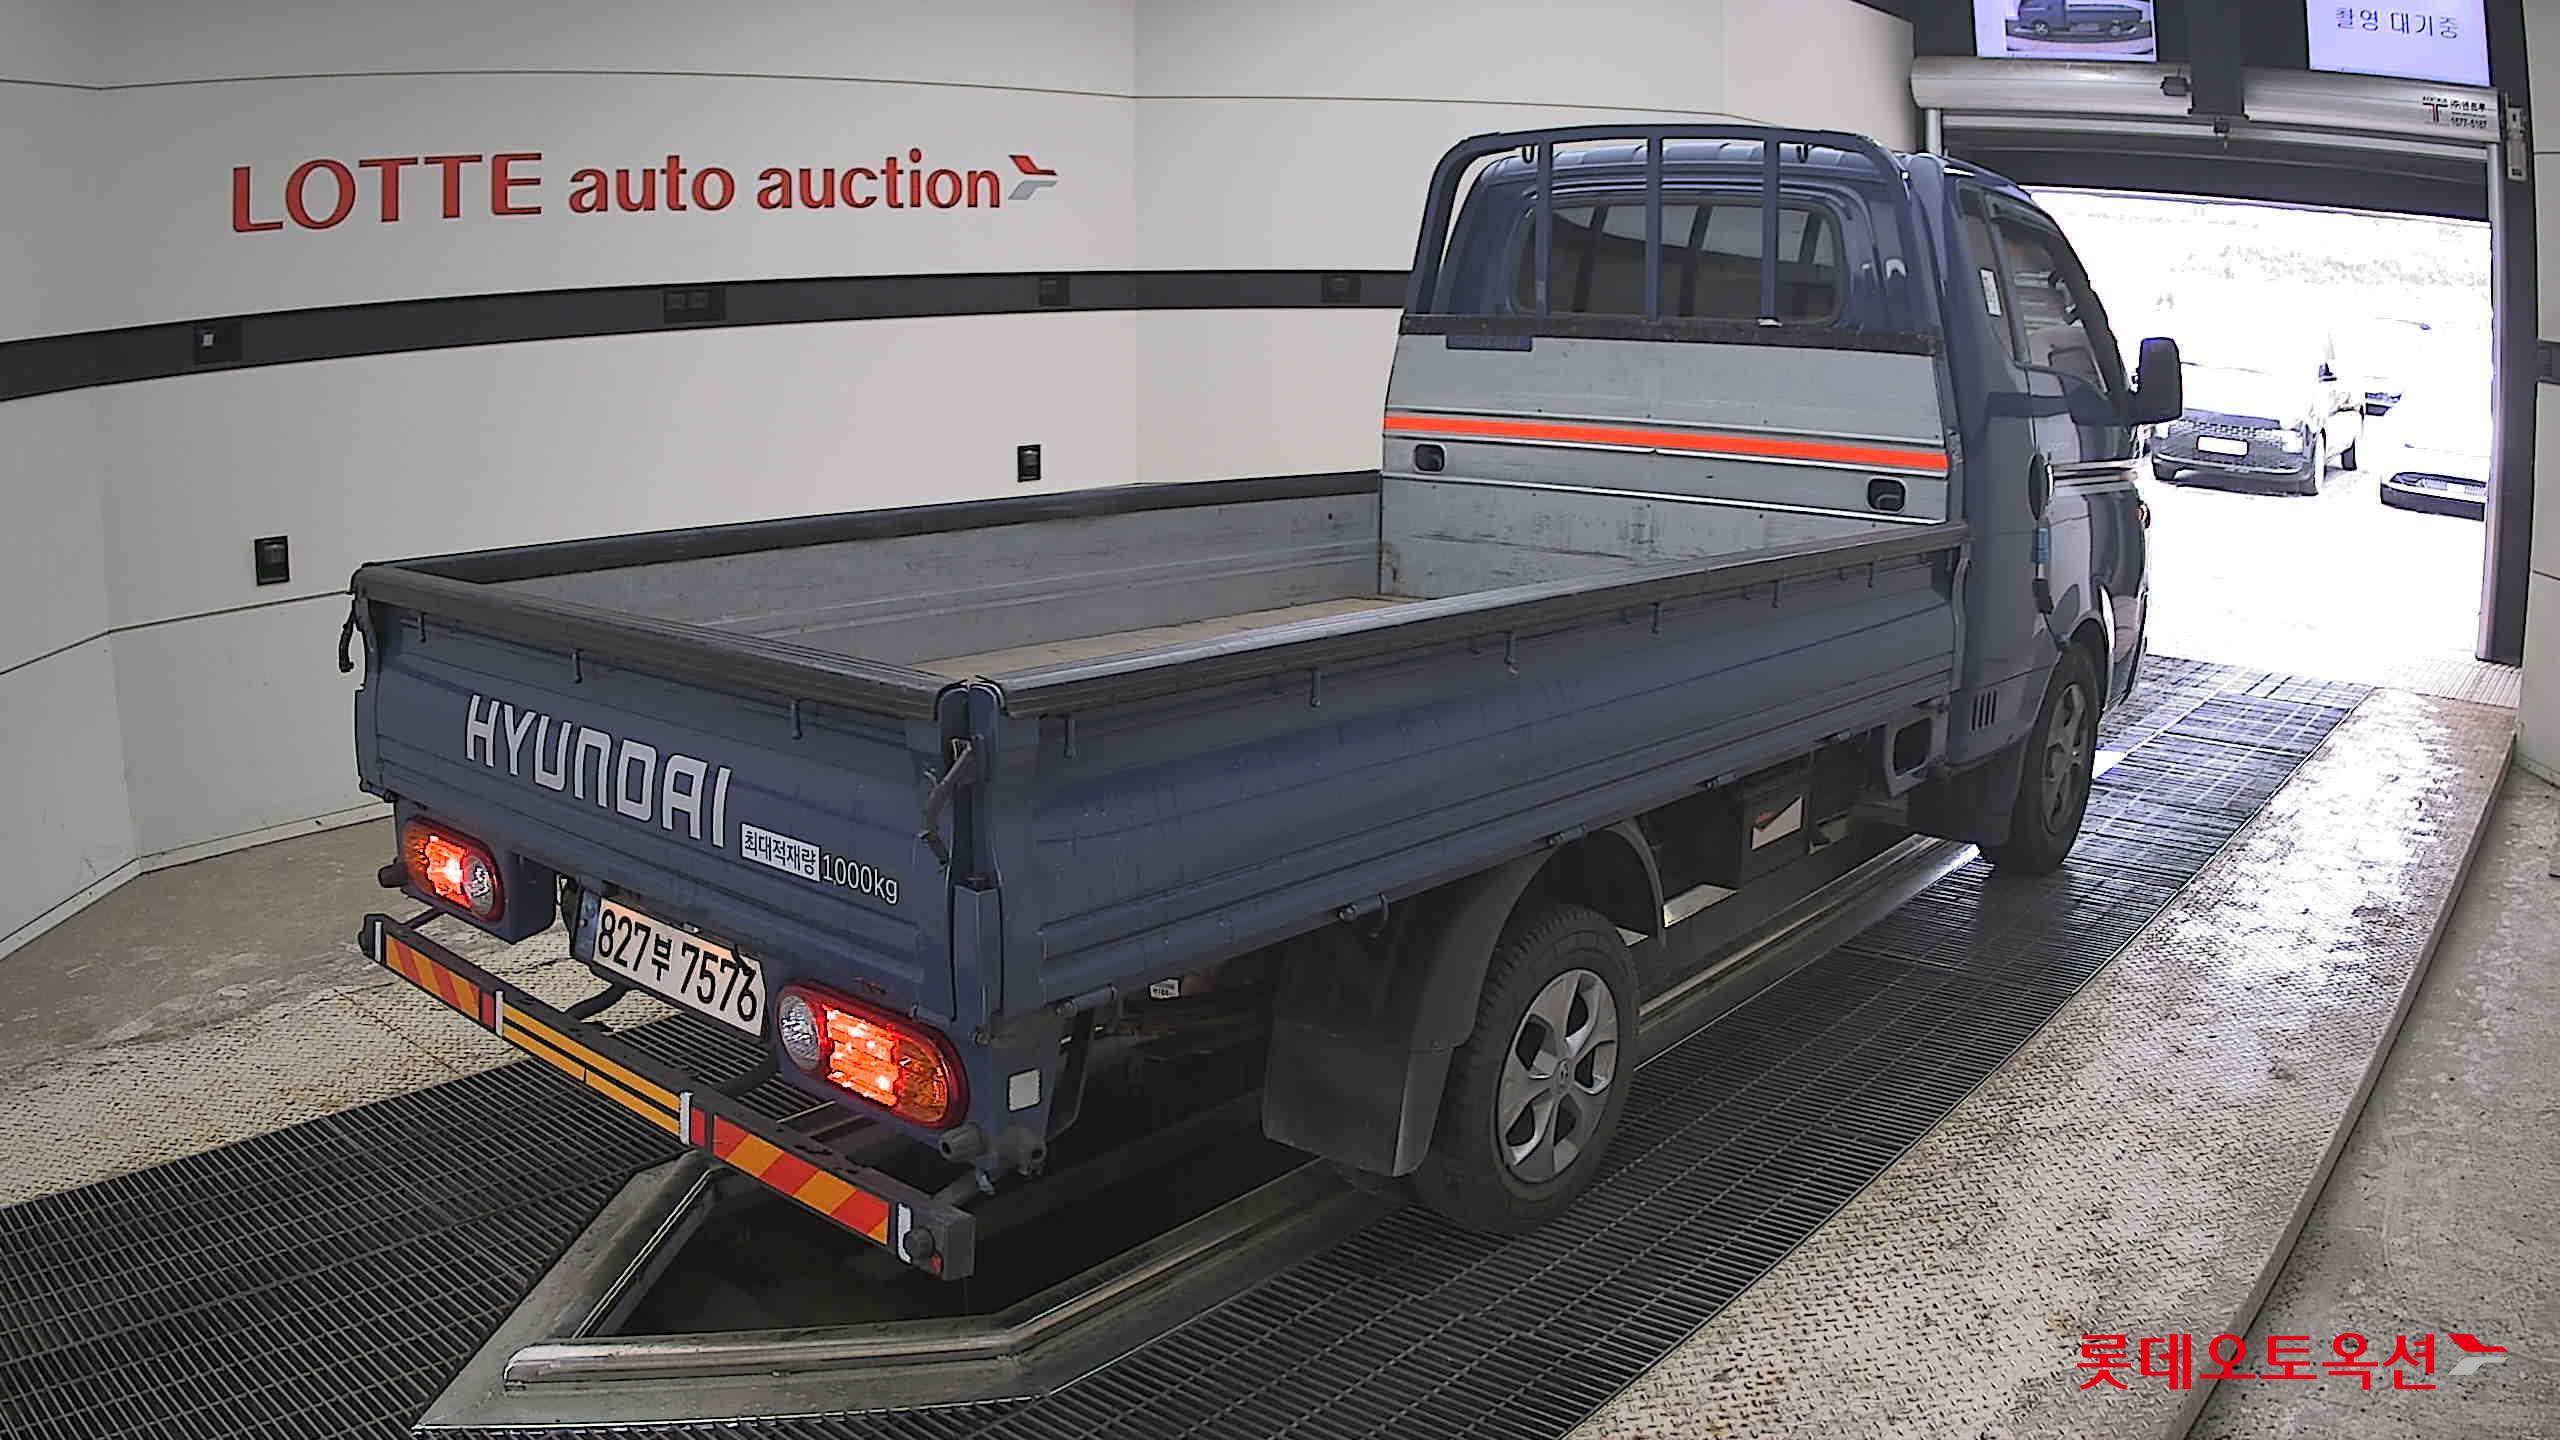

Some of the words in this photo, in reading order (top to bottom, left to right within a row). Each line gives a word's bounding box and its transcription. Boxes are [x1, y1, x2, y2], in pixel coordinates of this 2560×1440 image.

[233, 152, 542, 233] LOTTE
[569, 154, 737, 214] auto
[757, 147, 1002, 210] auction
[465, 694, 731, 847] HYUNDAI
[744, 830, 816, 875] 최대적재량
[599, 909, 672, 982] 827부
[681, 941, 757, 1021] 7576
